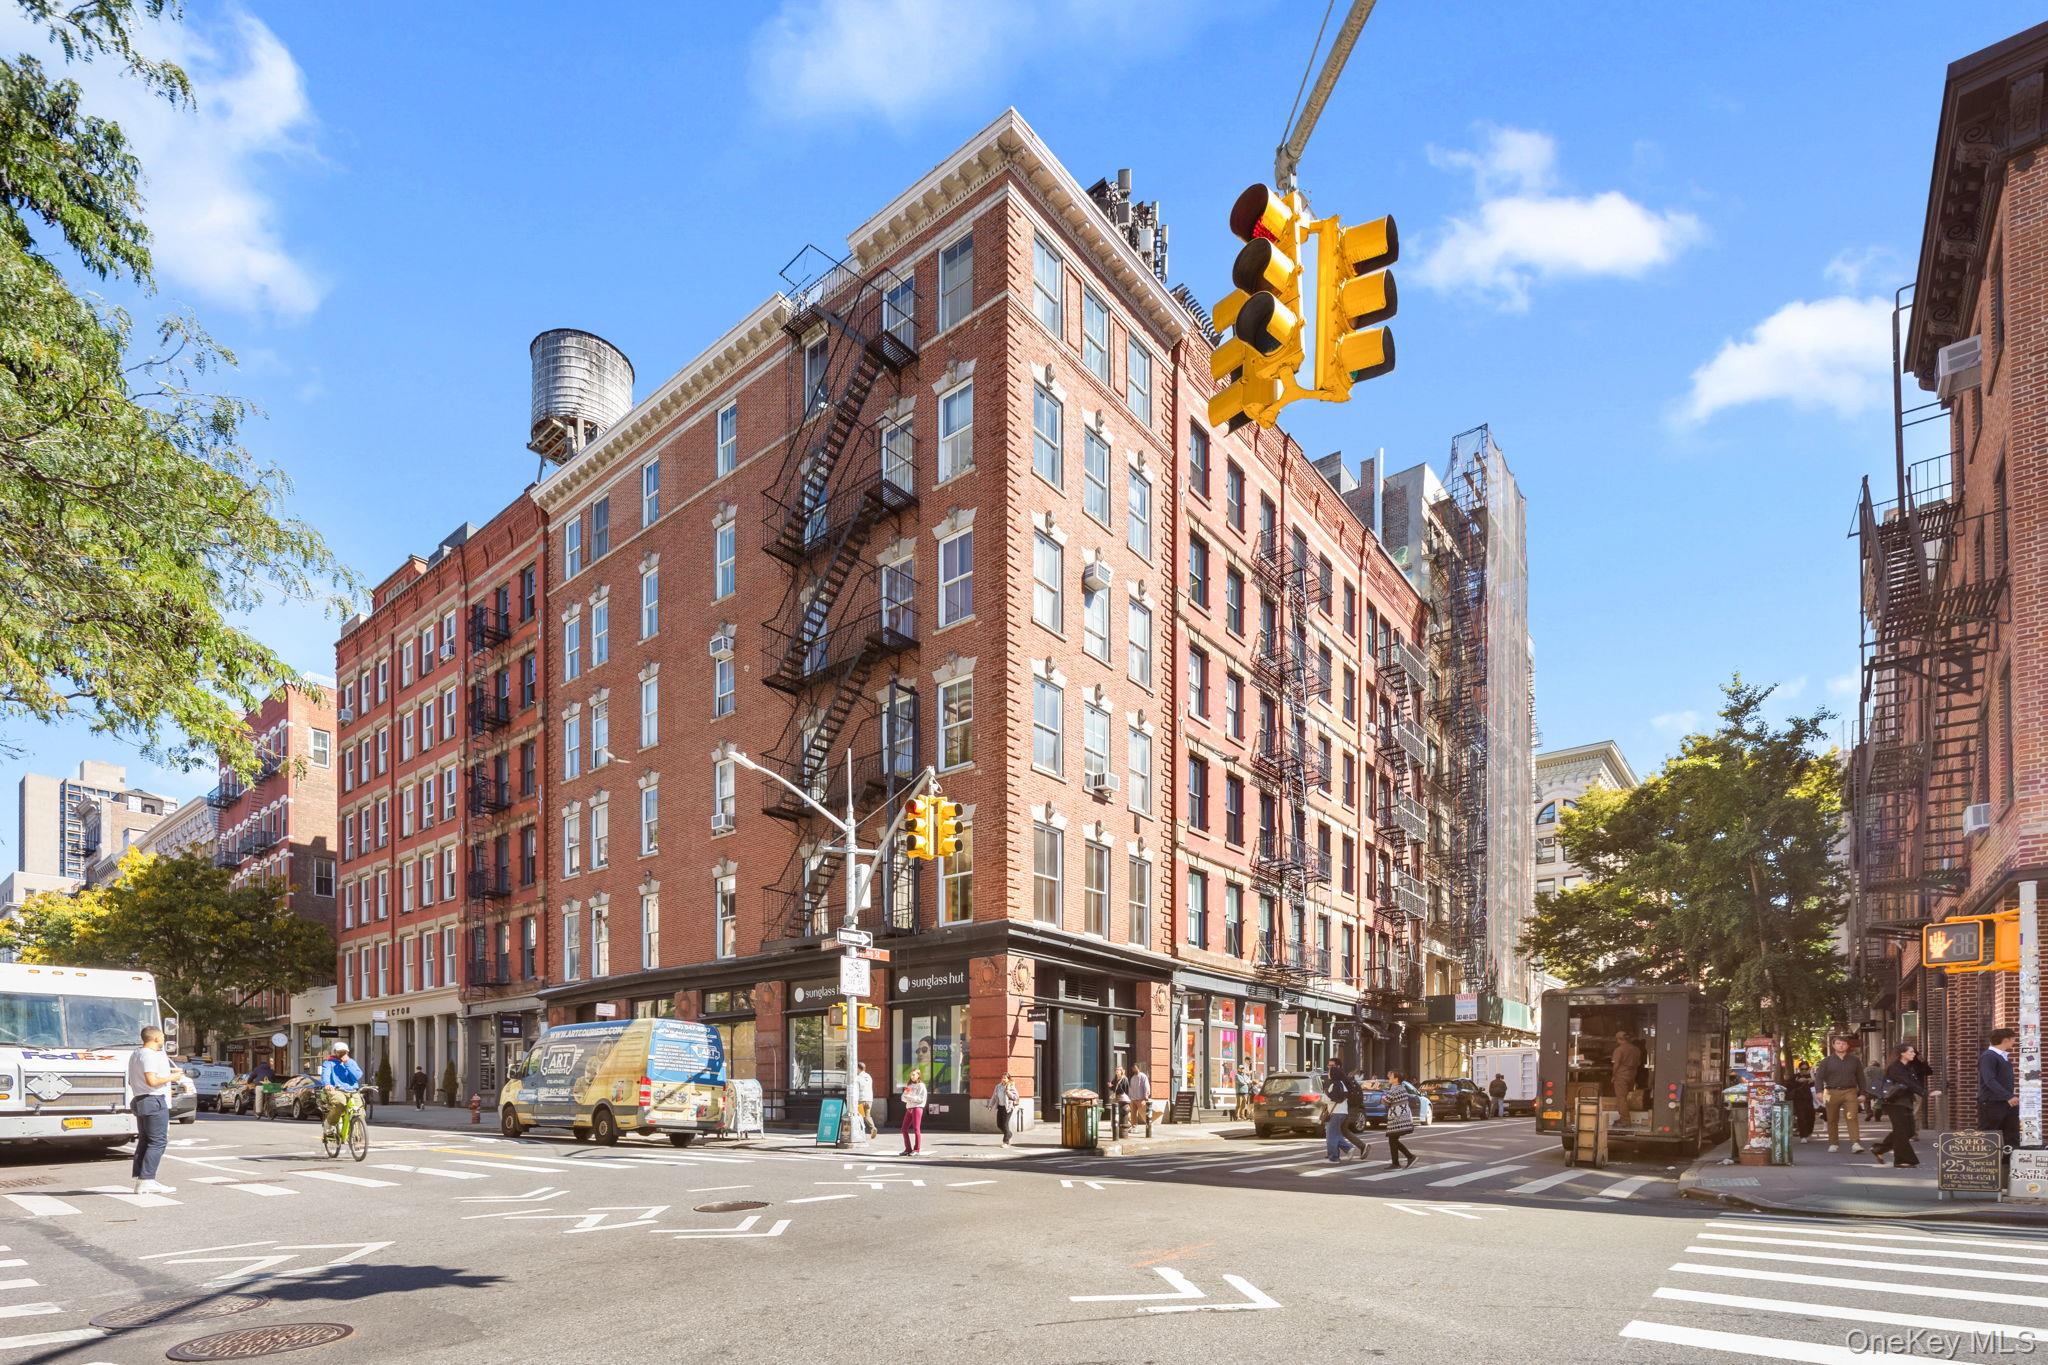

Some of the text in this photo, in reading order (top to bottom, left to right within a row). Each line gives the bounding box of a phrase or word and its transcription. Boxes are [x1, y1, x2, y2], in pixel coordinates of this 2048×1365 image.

[912, 972, 964, 990] sunglass hut
[805, 986, 835, 1000] sunglass
[22, 1051, 117, 1060] FedEx
[549, 1053, 570, 1068] ART
[1954, 1138, 1985, 1146] SOHO
[1942, 1159, 1966, 1173] $25
[1966, 1166, 1998, 1174] Readings
